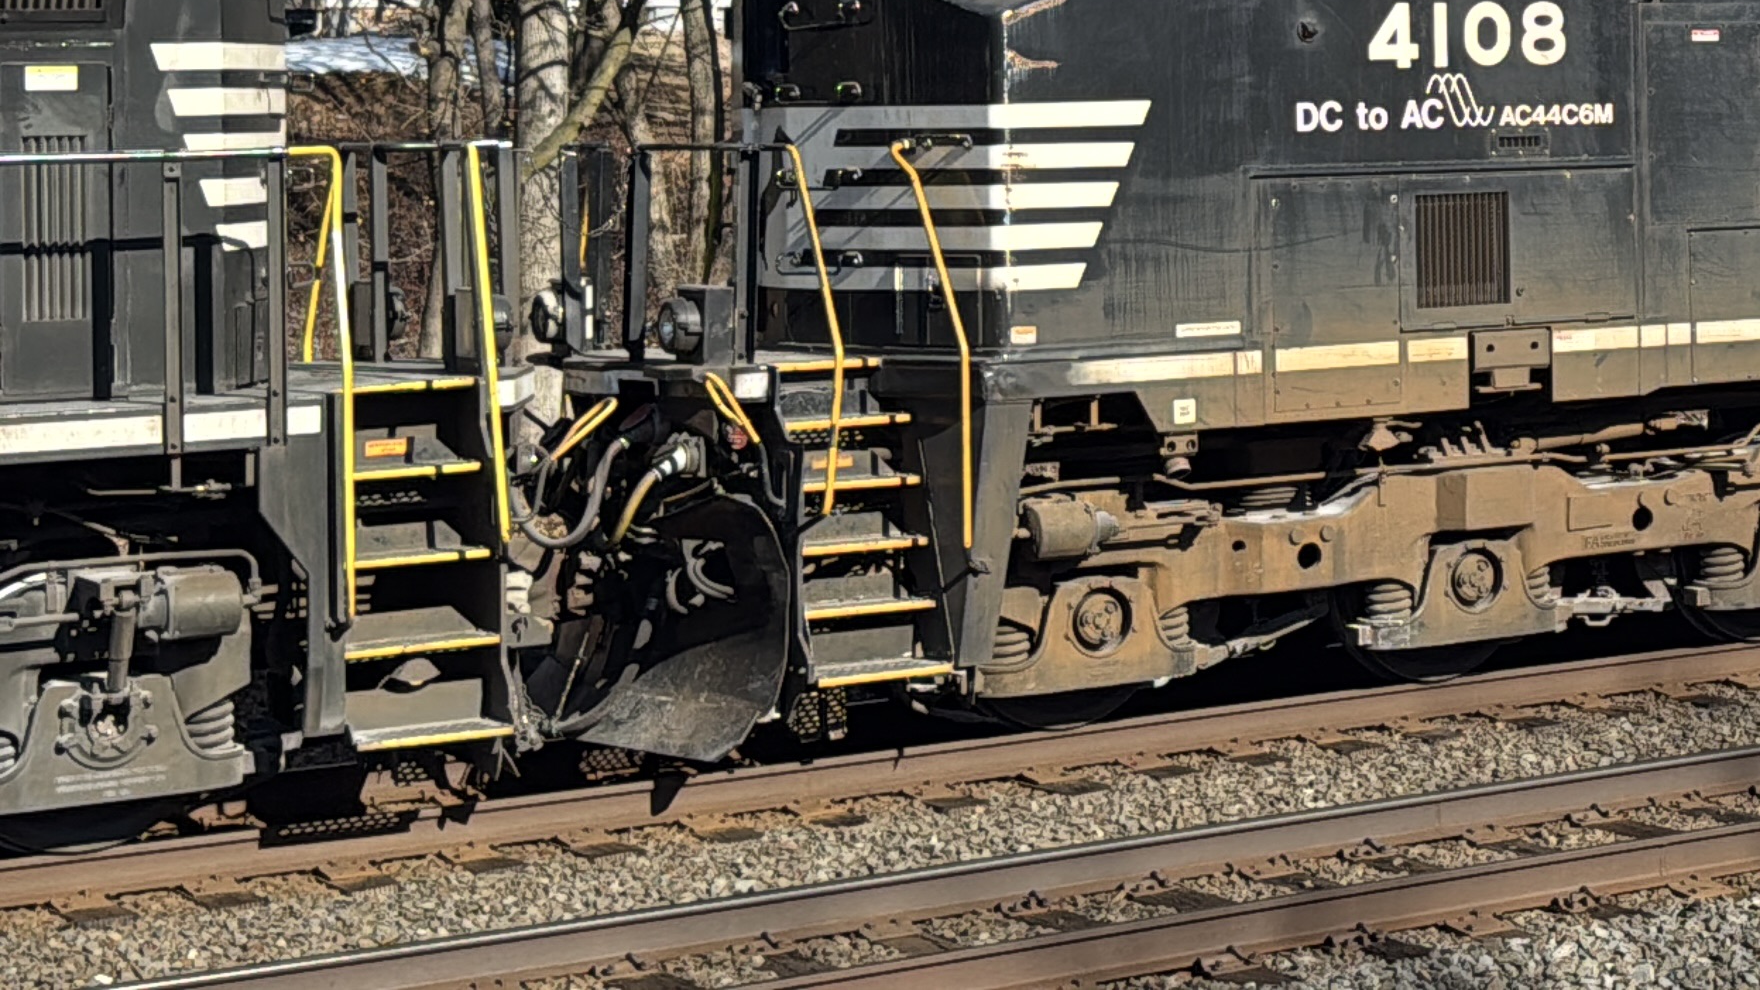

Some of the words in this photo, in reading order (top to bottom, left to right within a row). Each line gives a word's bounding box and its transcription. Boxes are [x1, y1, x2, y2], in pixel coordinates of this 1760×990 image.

[1368, 1, 1566, 69] 4108
[1296, 101, 1343, 132] DC
[1356, 102, 1388, 130] to
[1401, 99, 1444, 129] AC
[1499, 103, 1614, 126] AC44C6M
